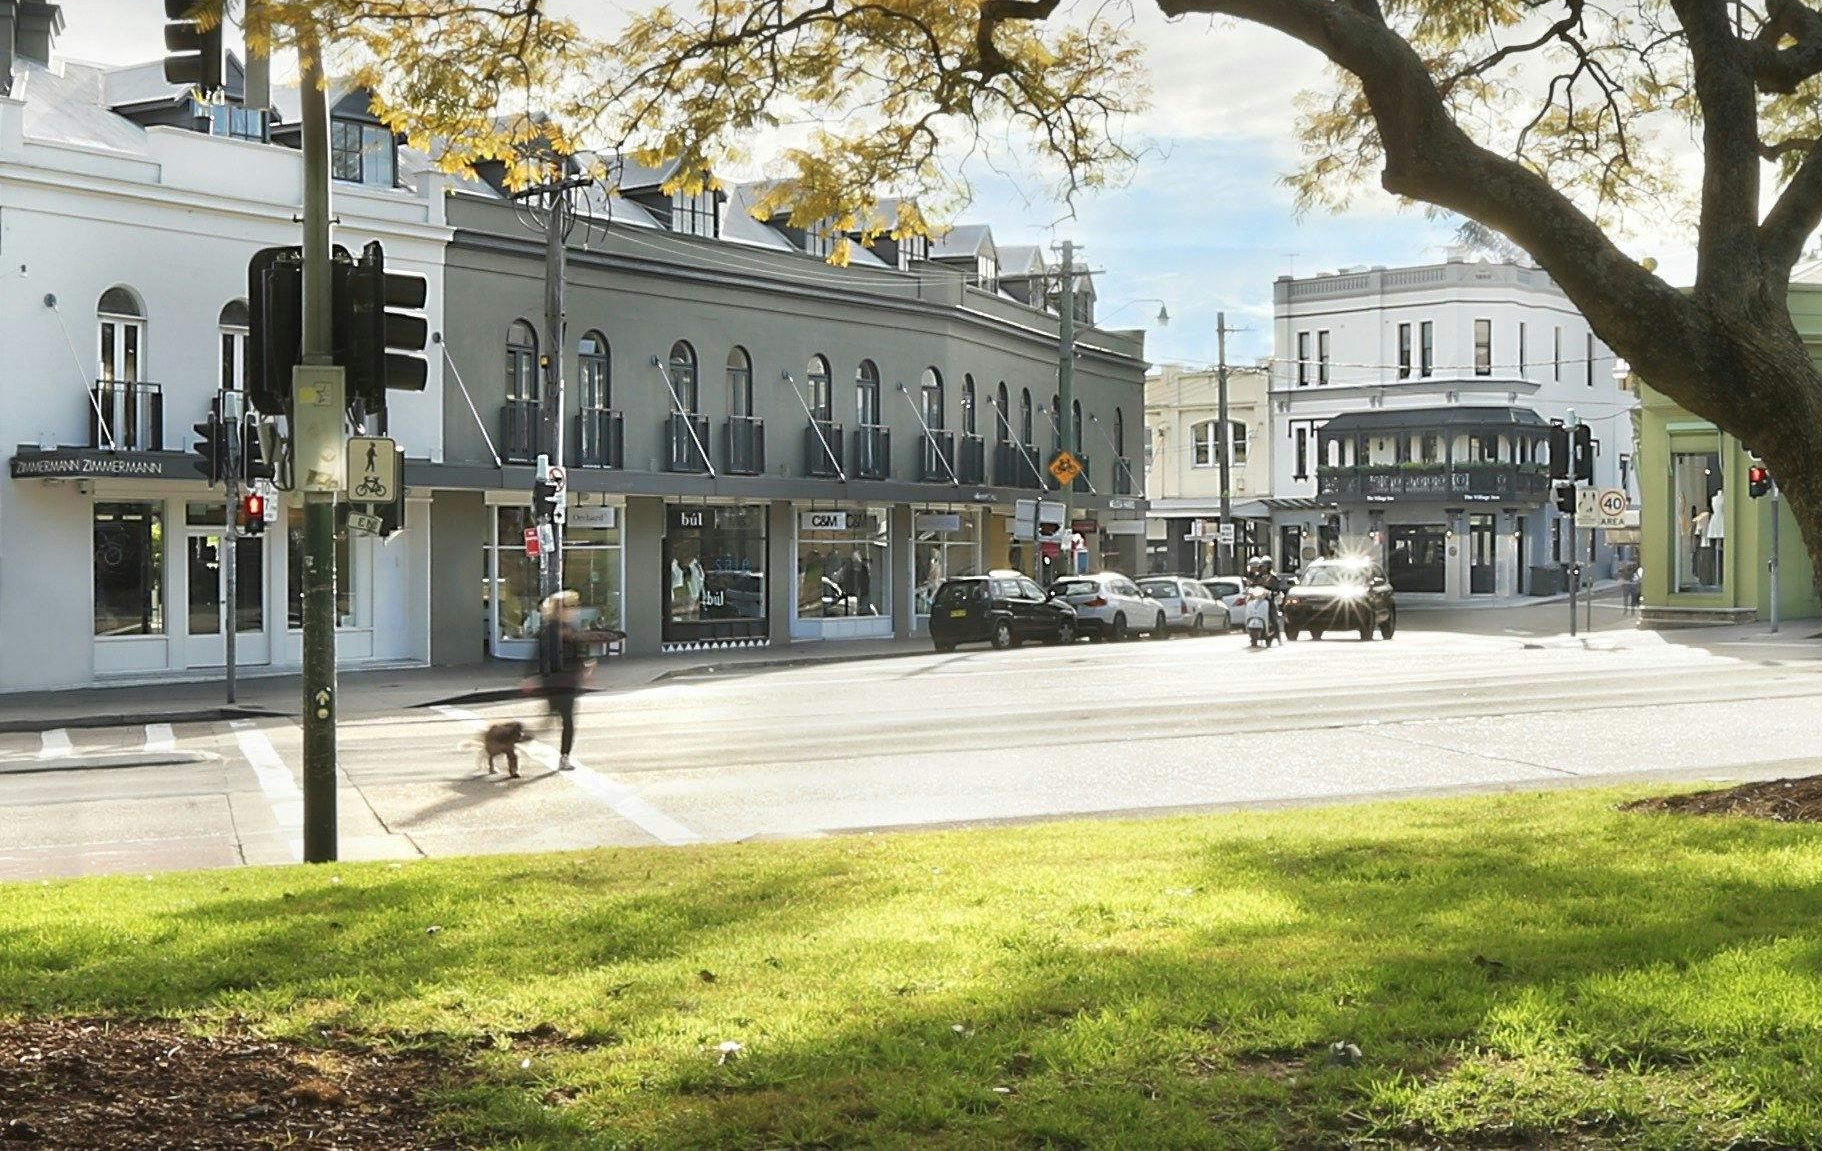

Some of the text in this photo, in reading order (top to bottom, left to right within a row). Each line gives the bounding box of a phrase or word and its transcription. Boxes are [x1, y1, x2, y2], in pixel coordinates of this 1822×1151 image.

[17, 459, 162, 474] ZIMMERMANN ZIMMERMANN
[1604, 497, 1622, 510] 40
[811, 515, 838, 528] C&M
